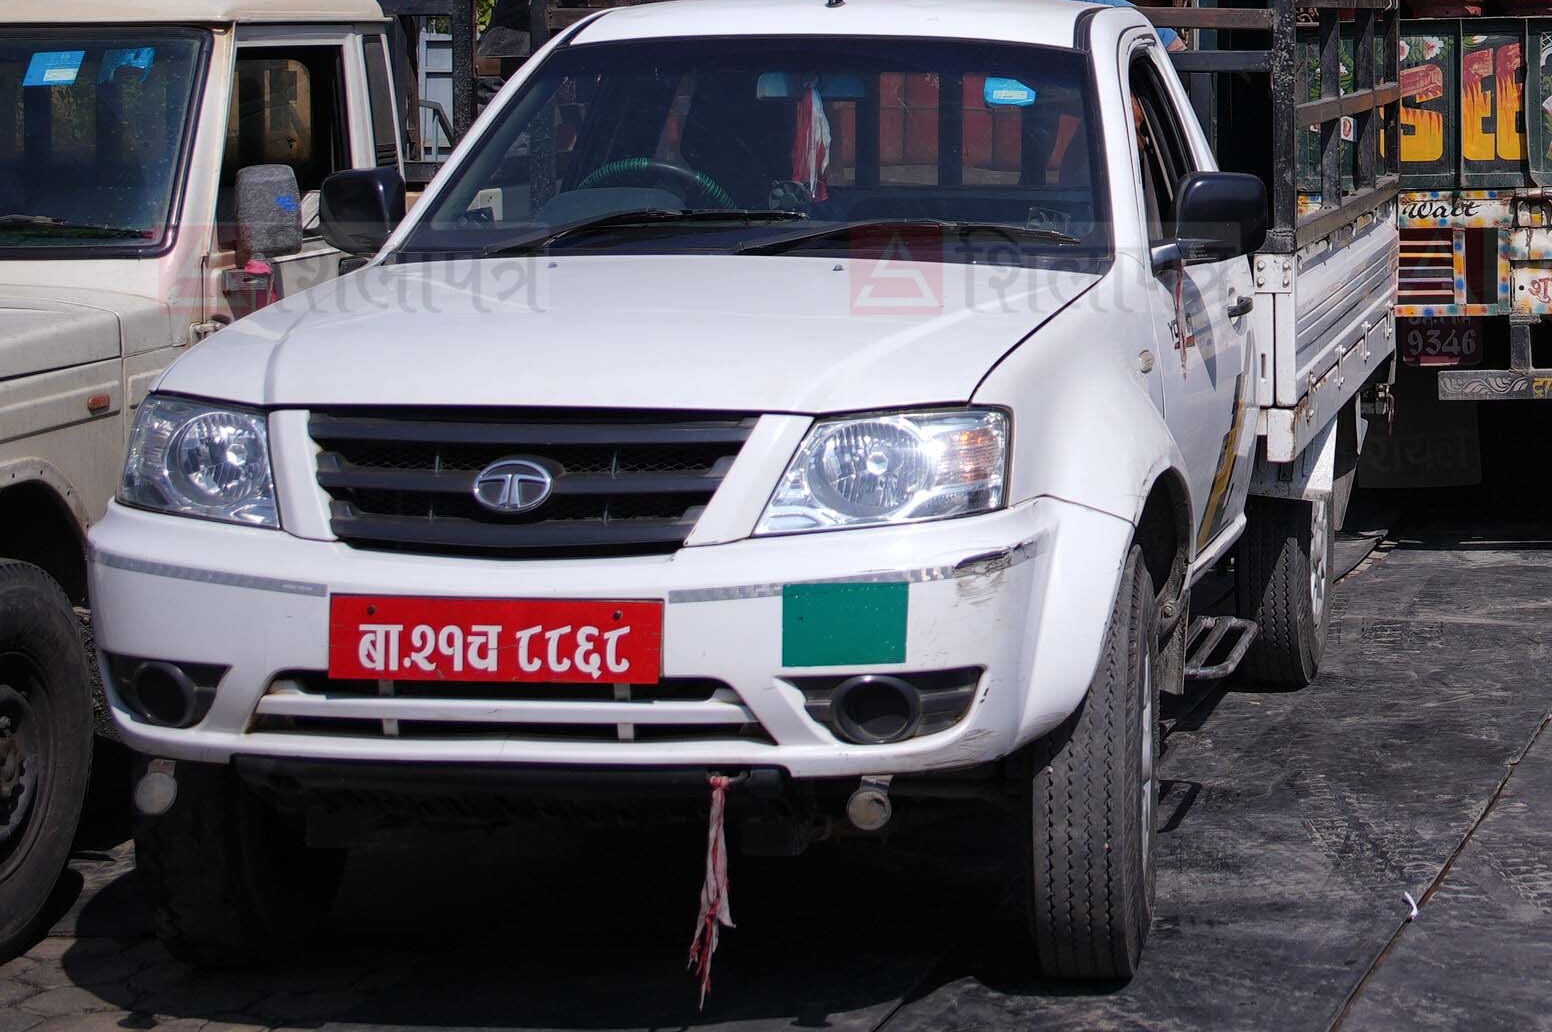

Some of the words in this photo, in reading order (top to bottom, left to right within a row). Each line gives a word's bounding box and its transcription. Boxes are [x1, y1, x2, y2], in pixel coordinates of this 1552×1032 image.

[1379, 43, 1527, 161] SEE
[1406, 328, 1477, 356] 9346
[515, 624, 631, 680] ८८६८
